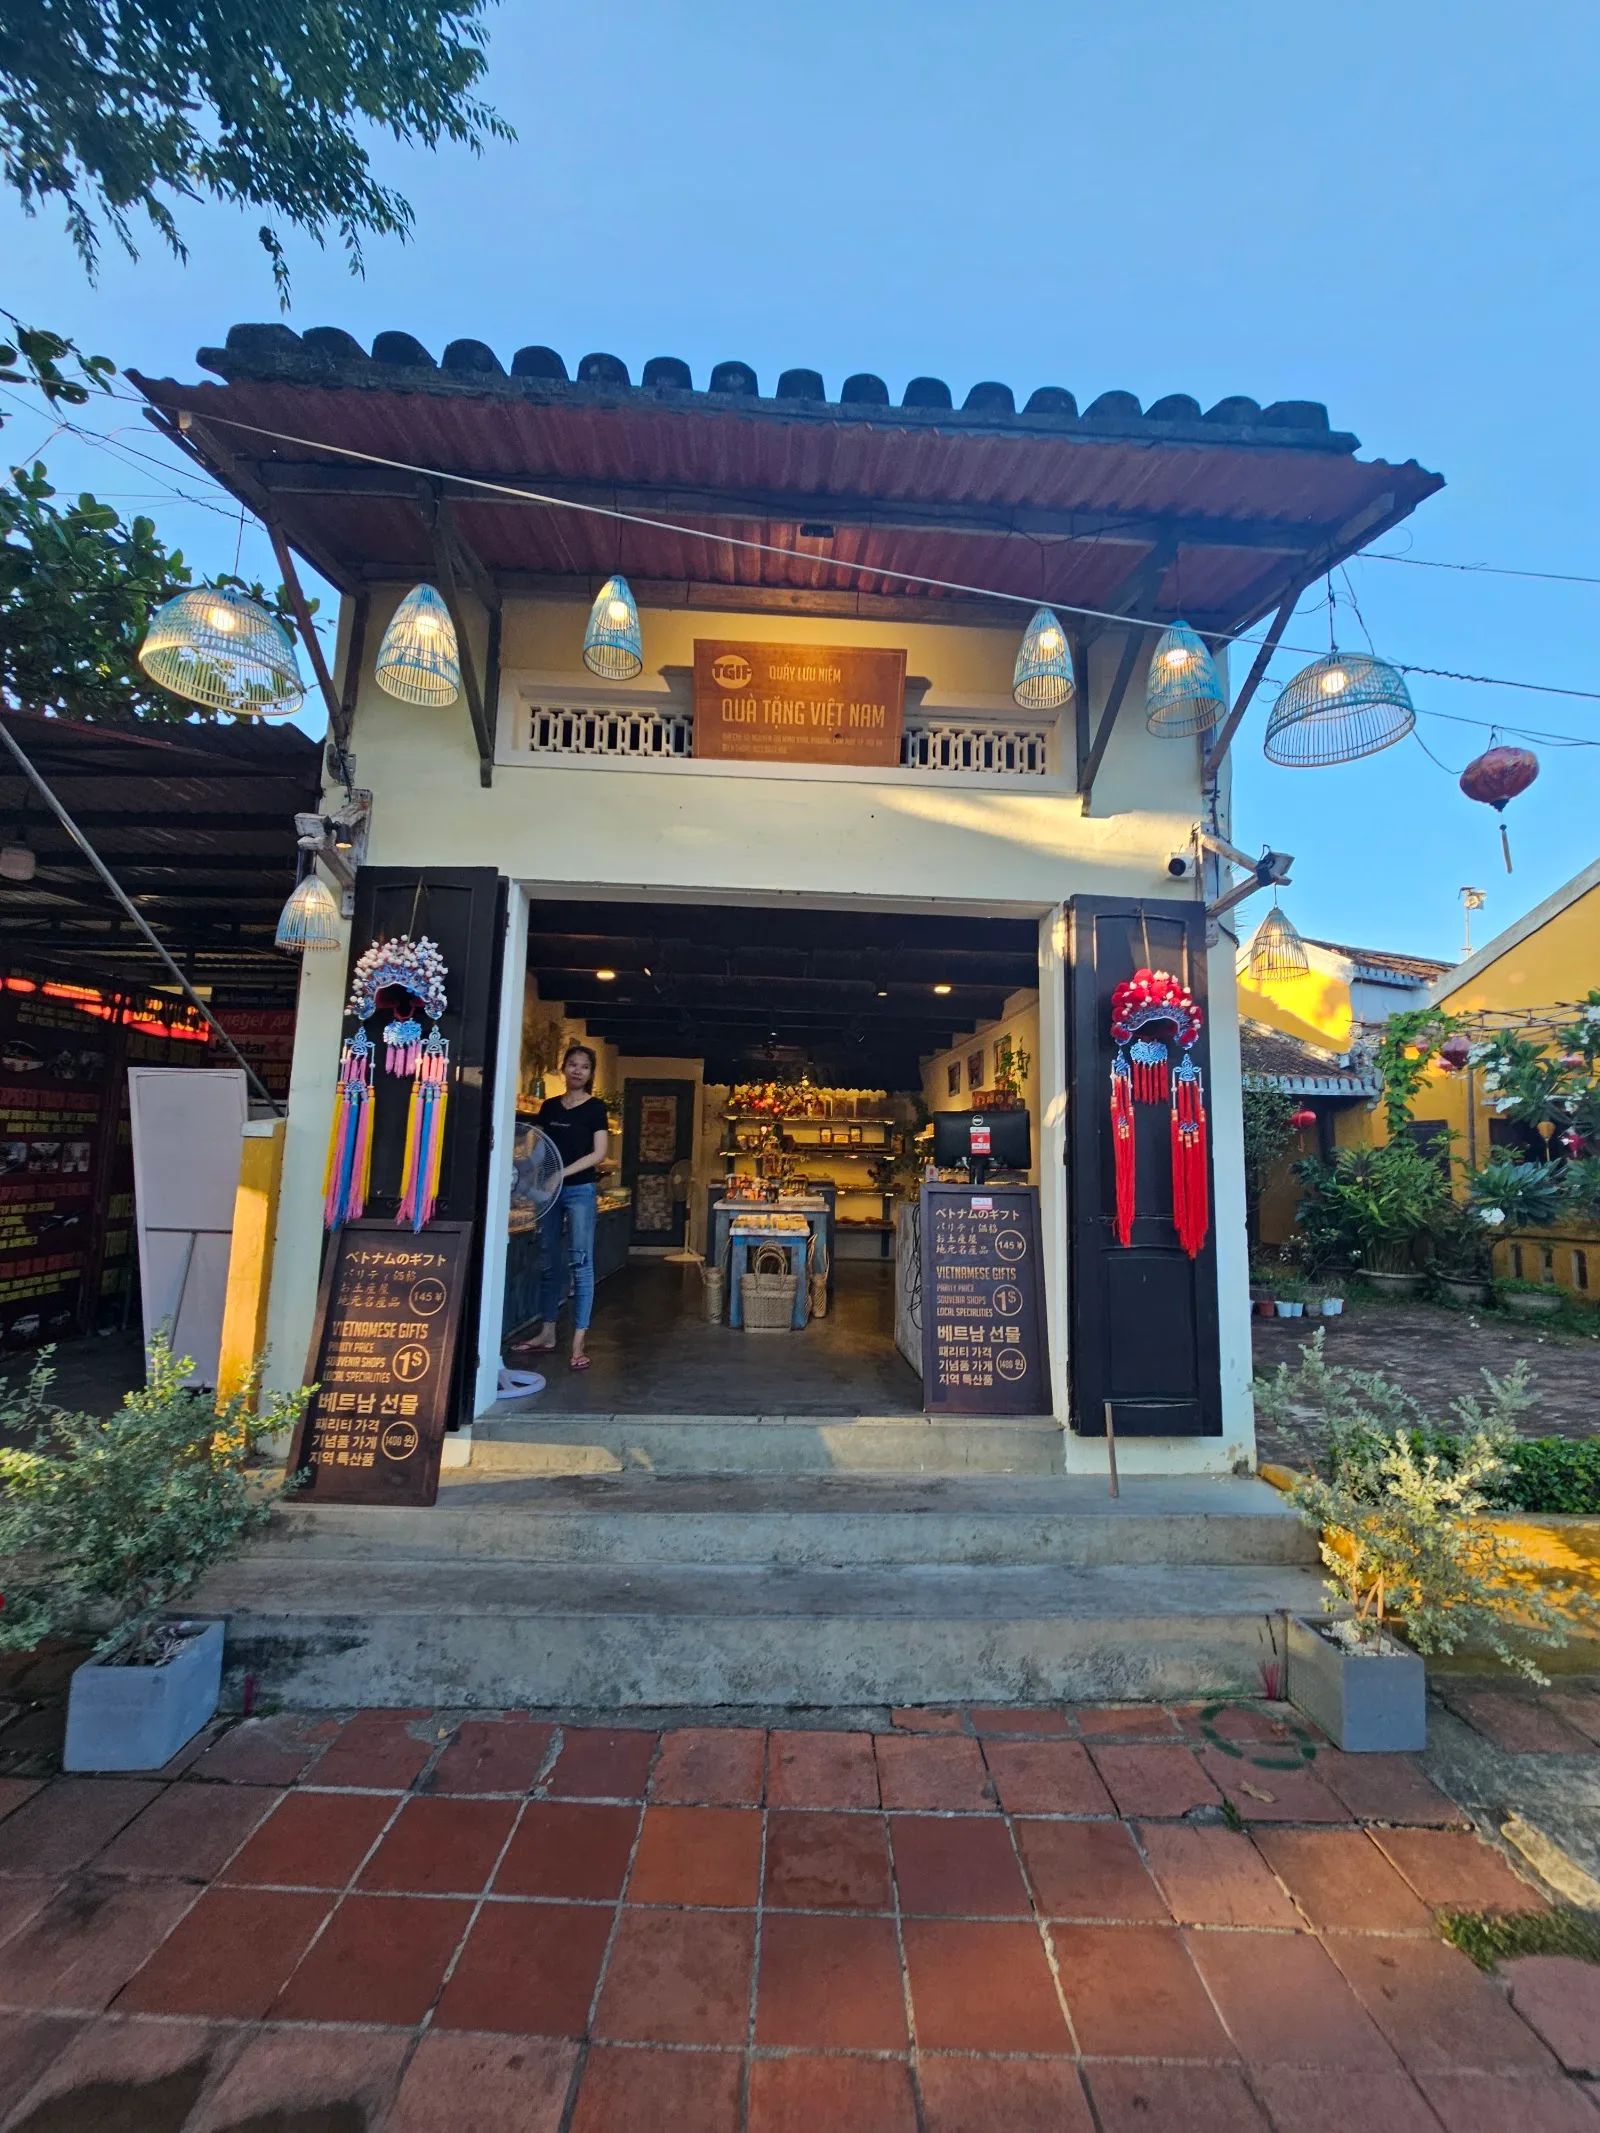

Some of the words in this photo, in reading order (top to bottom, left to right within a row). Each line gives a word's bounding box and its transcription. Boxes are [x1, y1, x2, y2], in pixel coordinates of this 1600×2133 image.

[722, 692, 757, 723] QUÀ
[762, 696, 805, 729] TẶNG
[810, 698, 844, 731] VIỆT
[849, 703, 886, 728] NAM
[210, 1039, 267, 1055] Jestar
[935, 1208, 1020, 1221] ベトナムのギフト
[345, 1251, 446, 1267] ベトナムのギフト
[936, 1266, 990, 1280] VIETNAMESE
[992, 1267, 1017, 1280] GIFTS
[414, 1292, 432, 1302] 145
[332, 1321, 397, 1339] VIETNAMESE
[398, 1323, 429, 1340] GIFTS
[937, 1324, 985, 1343] 베트남
[989, 1325, 1021, 1344] 선물
[1014, 1359, 1024, 1370] 원
[322, 1370, 344, 1382] LOCAL
[938, 1374, 960, 1385] 지역
[318, 1392, 377, 1414] 베트남
[380, 1393, 419, 1416] 선물
[354, 1419, 380, 1433] 가격
[311, 1434, 350, 1449] 기념품
[351, 1435, 378, 1450] 가게
[403, 1434, 415, 1448] 원
[308, 1451, 335, 1465] 지역
